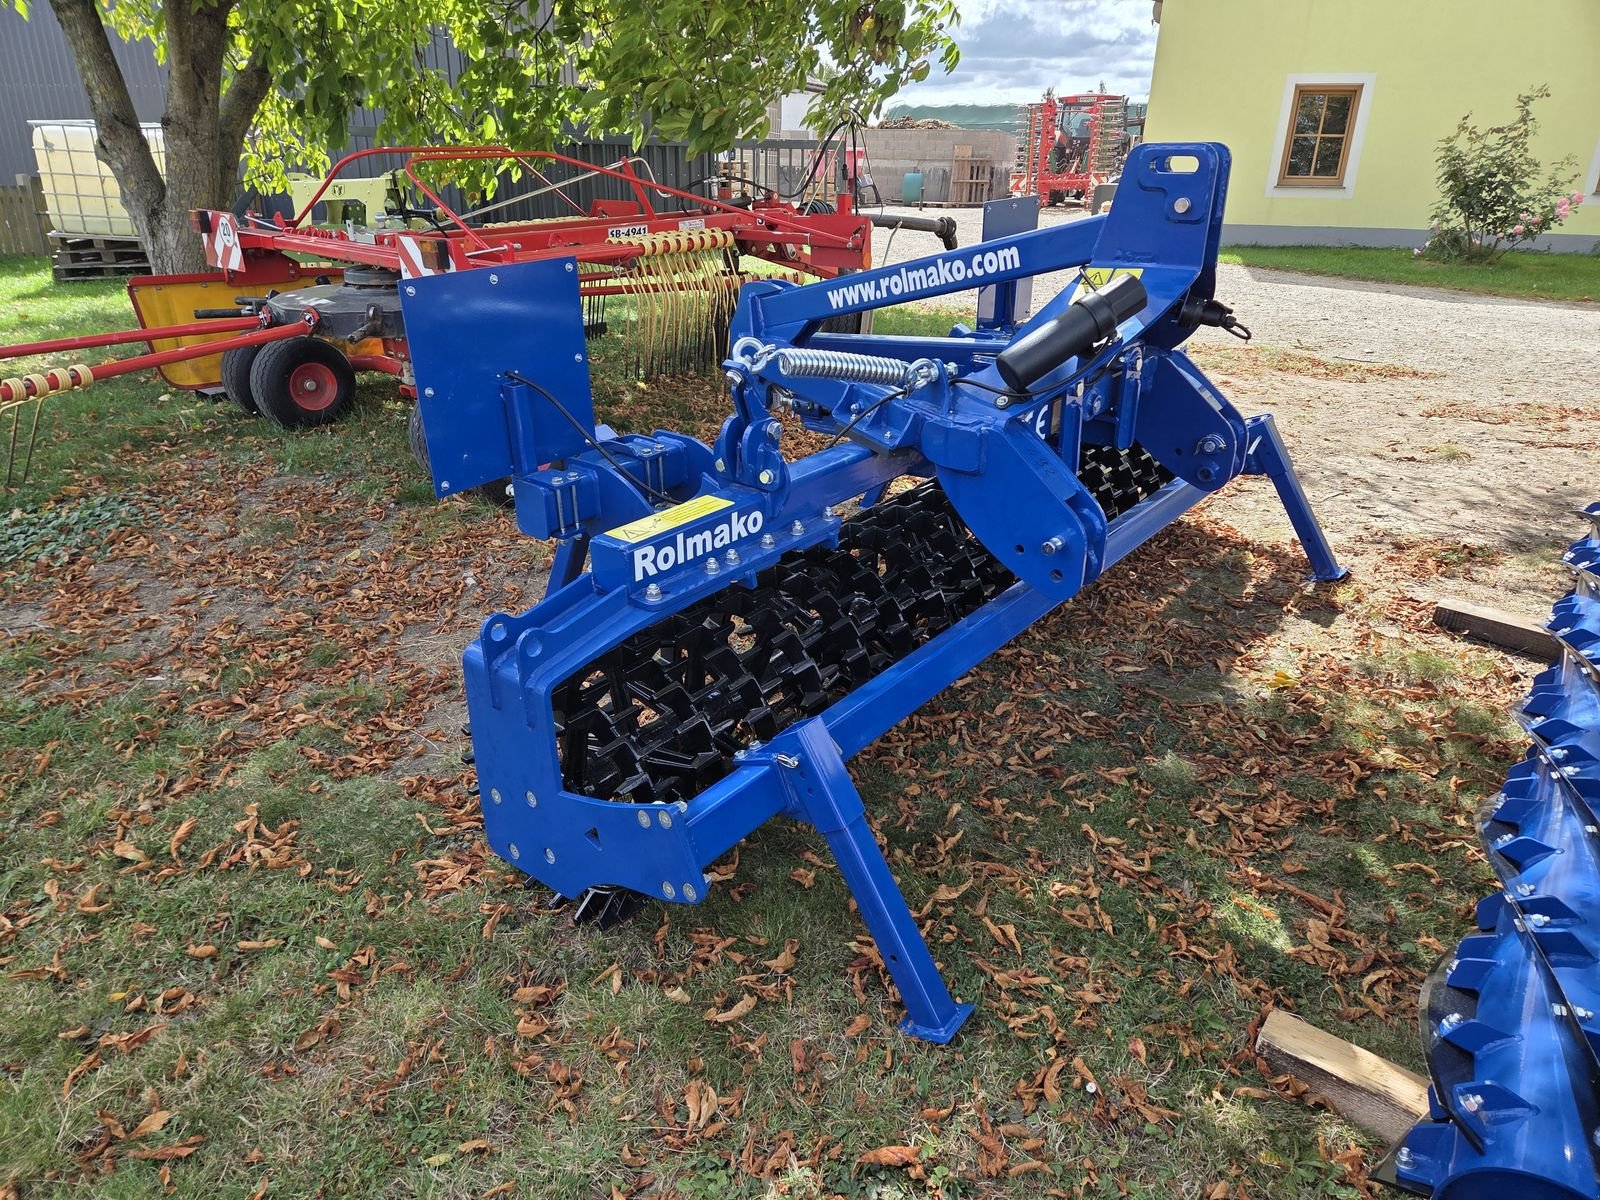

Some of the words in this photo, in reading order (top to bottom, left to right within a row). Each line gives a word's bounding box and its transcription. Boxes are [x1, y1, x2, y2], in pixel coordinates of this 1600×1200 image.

[221, 222, 231, 237] 20
[610, 227, 647, 239] SB-4941
[827, 246, 1021, 310] www.rolmako.com
[633, 510, 764, 582] Rolmako
